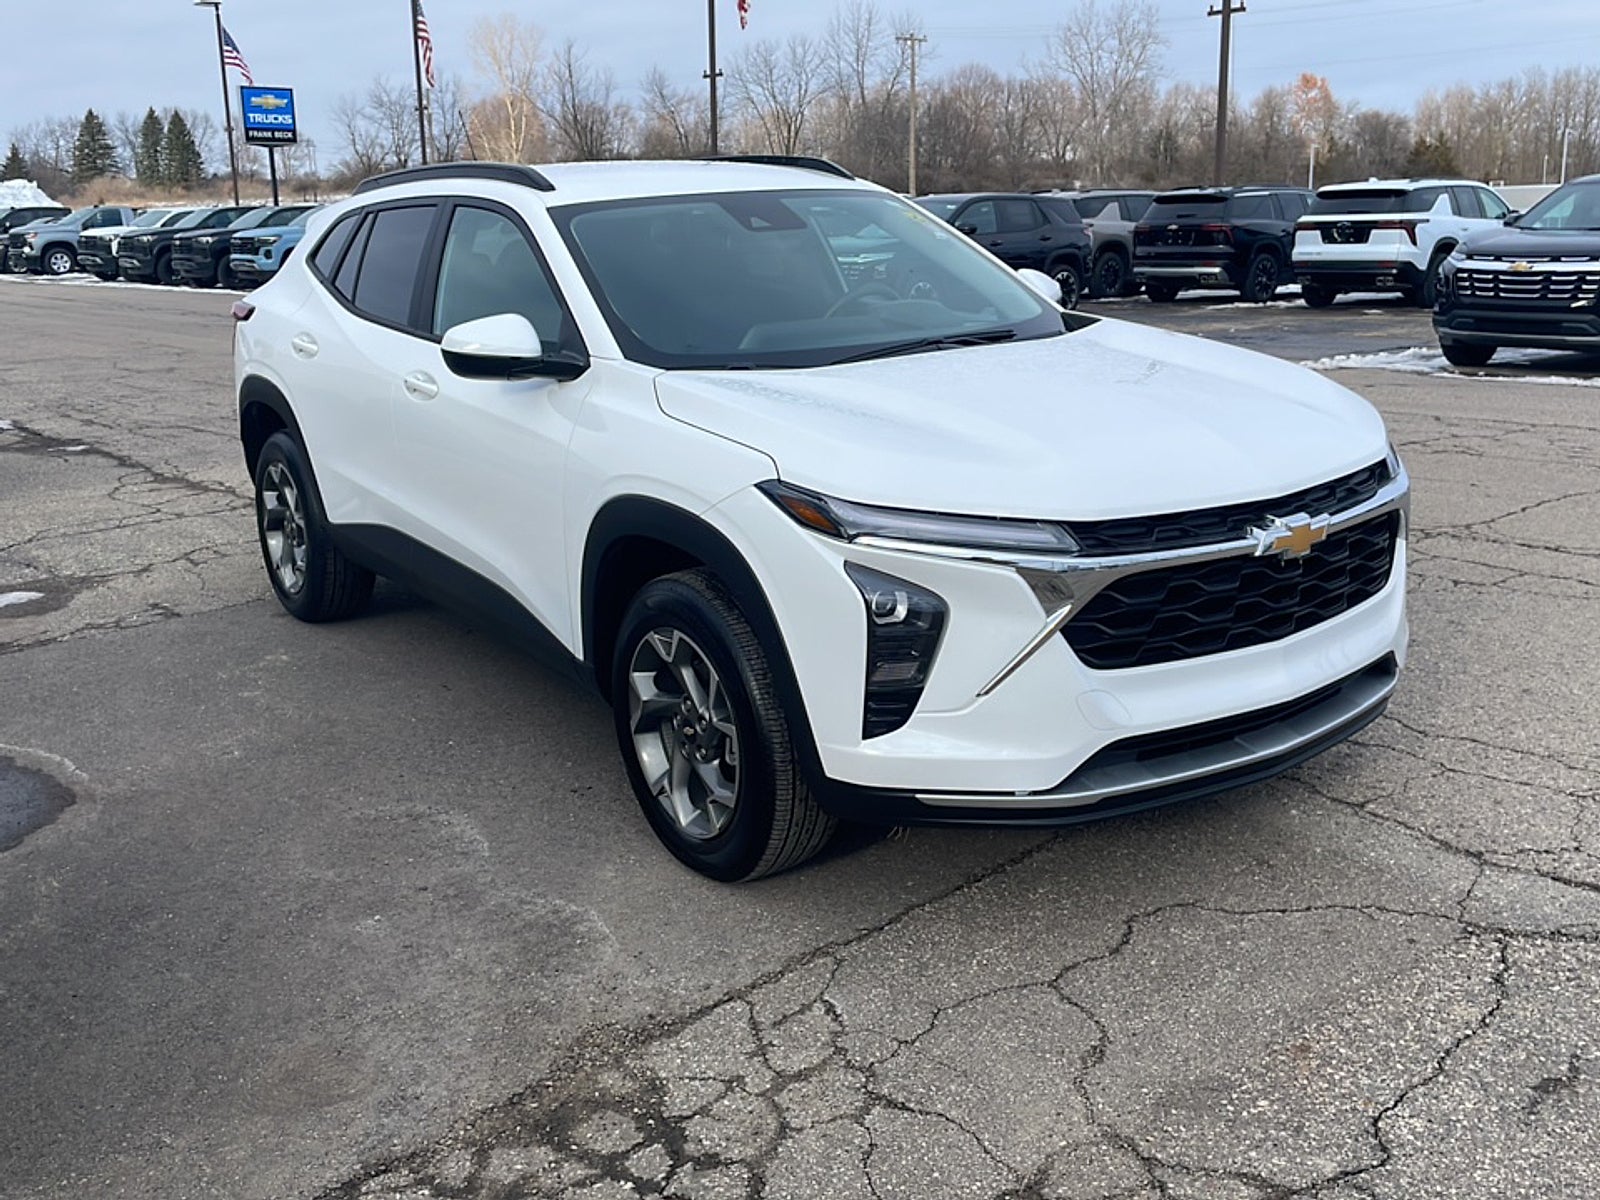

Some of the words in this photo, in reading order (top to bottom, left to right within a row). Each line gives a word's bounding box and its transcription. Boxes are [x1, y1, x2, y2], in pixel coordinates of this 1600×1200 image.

[247, 113, 293, 124] TRUCKS
[249, 130, 272, 138] FRANK
[274, 131, 293, 139] BECK
